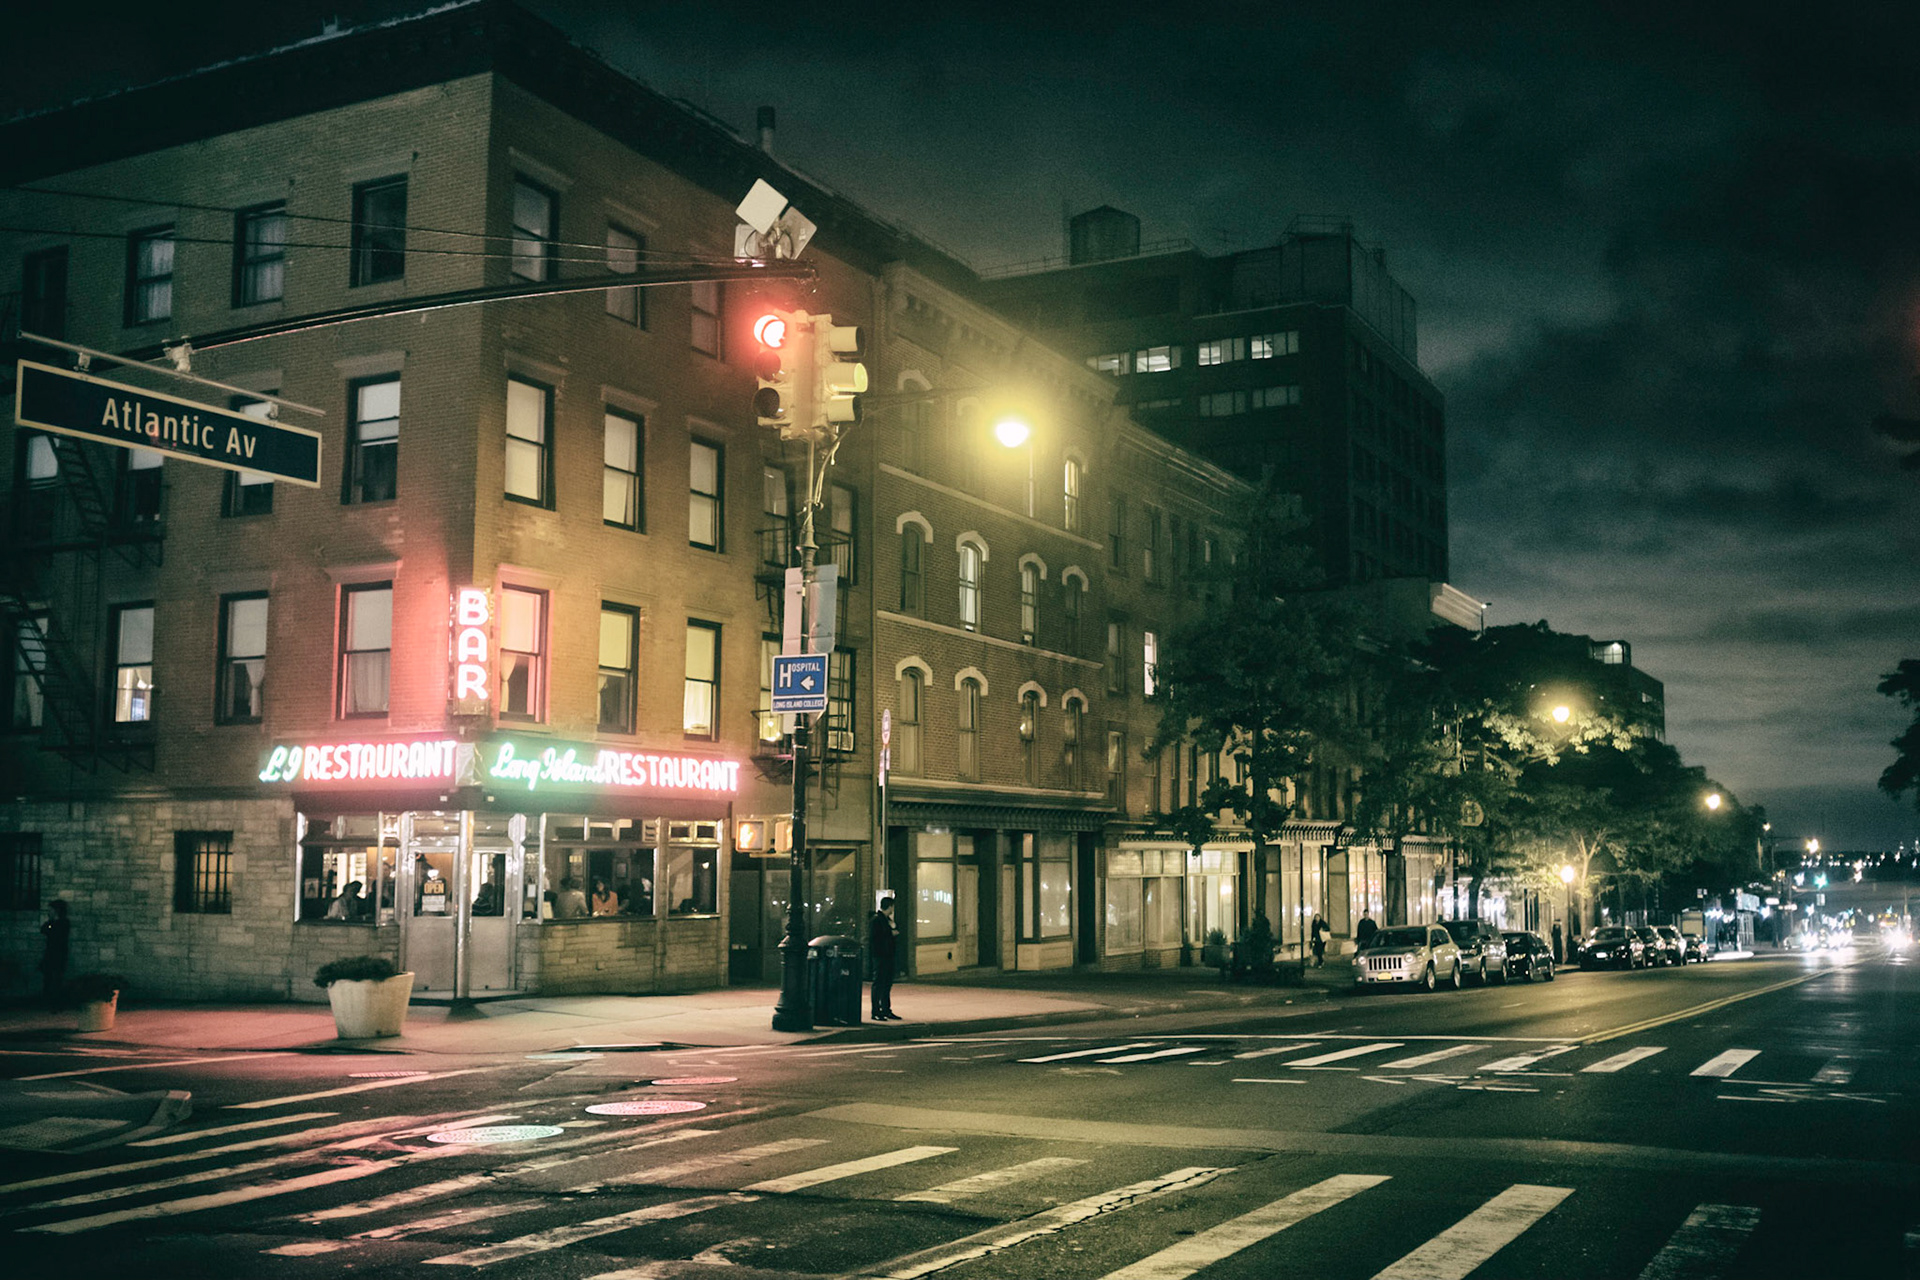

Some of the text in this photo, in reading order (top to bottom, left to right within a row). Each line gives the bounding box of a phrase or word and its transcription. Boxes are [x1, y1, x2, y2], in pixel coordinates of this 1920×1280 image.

[102, 398, 257, 458] Atlantic Av
[457, 590, 489, 699] BAR
[780, 663, 820, 688] HOSPITAL
[303, 740, 458, 780] RESTAURANT
[490, 742, 740, 791] Long Island RESTAURANT
[424, 882, 445, 894] OPEN
